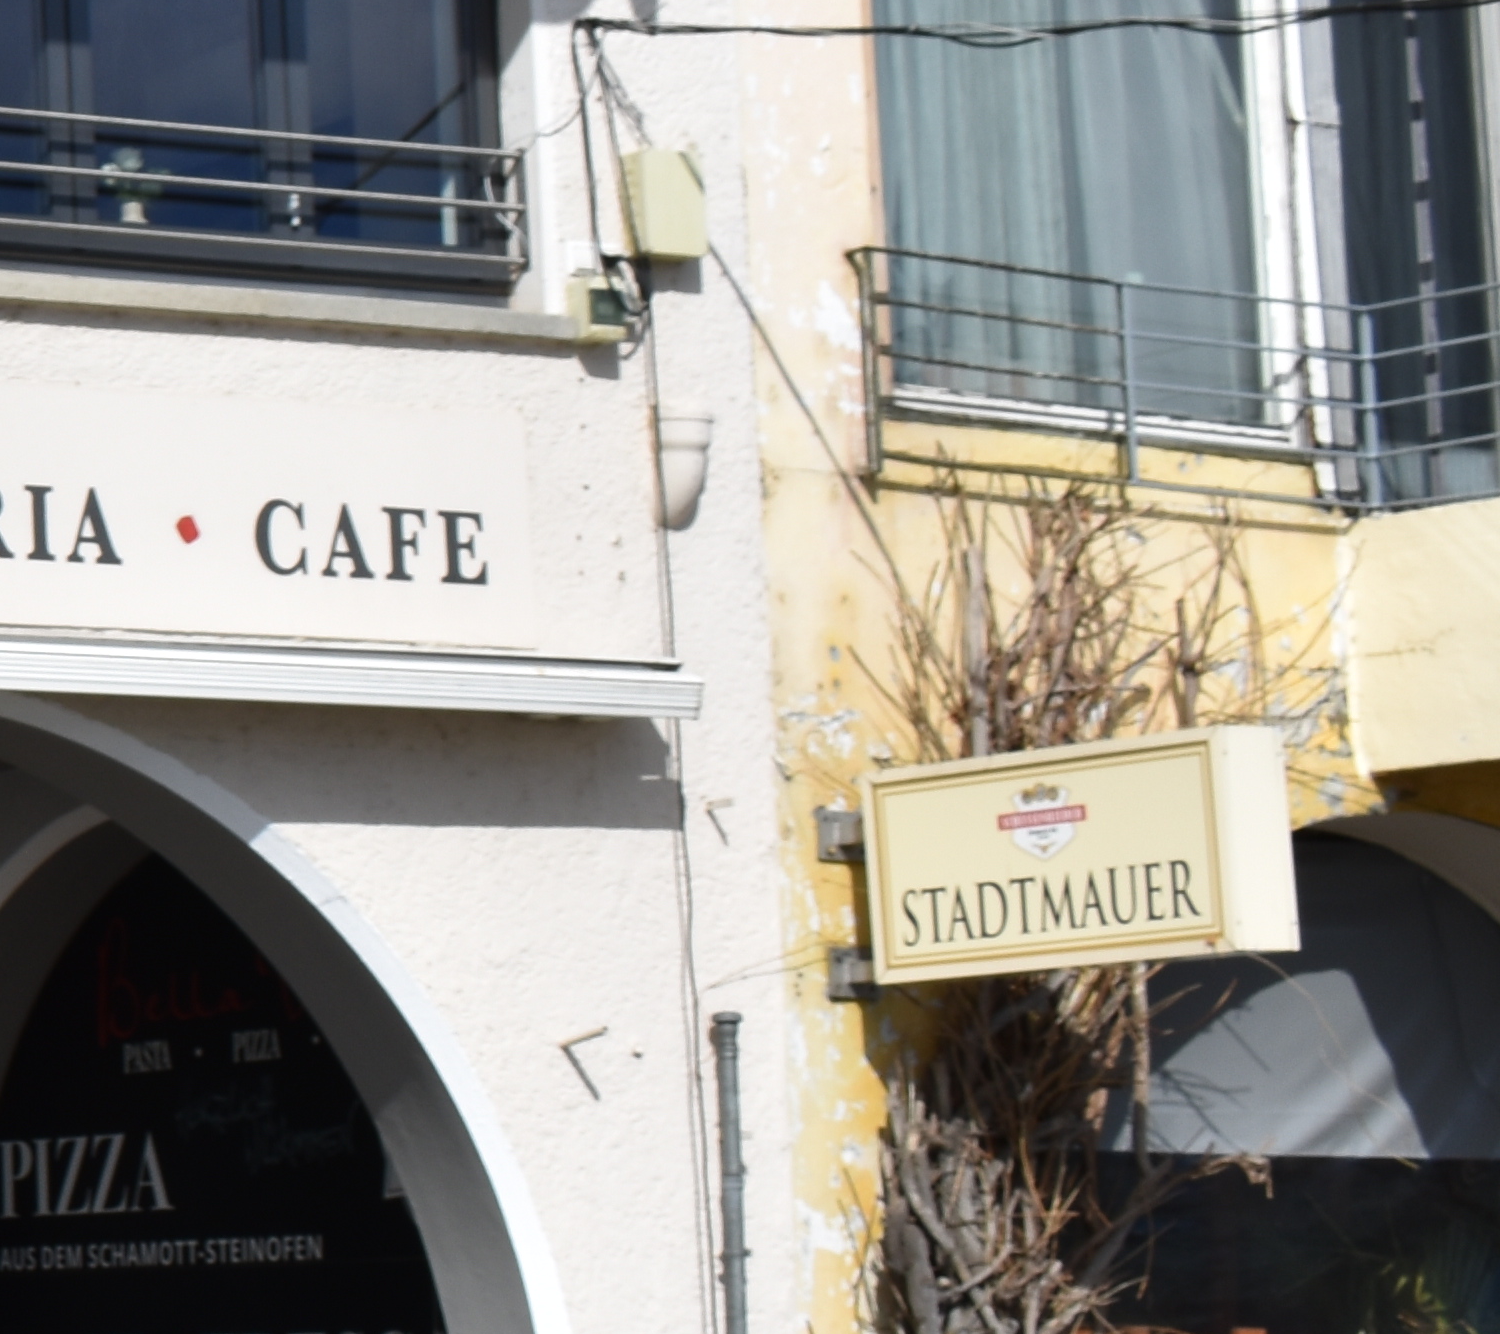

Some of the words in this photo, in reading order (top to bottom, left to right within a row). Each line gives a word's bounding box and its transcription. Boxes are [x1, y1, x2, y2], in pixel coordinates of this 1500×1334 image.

[254, 498, 490, 586] CAFE
[902, 860, 1200, 947] STADTMAUER
[122, 1039, 173, 1075] PASTA
[231, 1028, 282, 1064] PIZZA
[0, 1133, 175, 1218] PIZZA
[0, 1245, 38, 1271] AUS
[41, 1244, 84, 1269] DEM
[87, 1235, 324, 1268] SCHAMOTT-STEINOFEN
